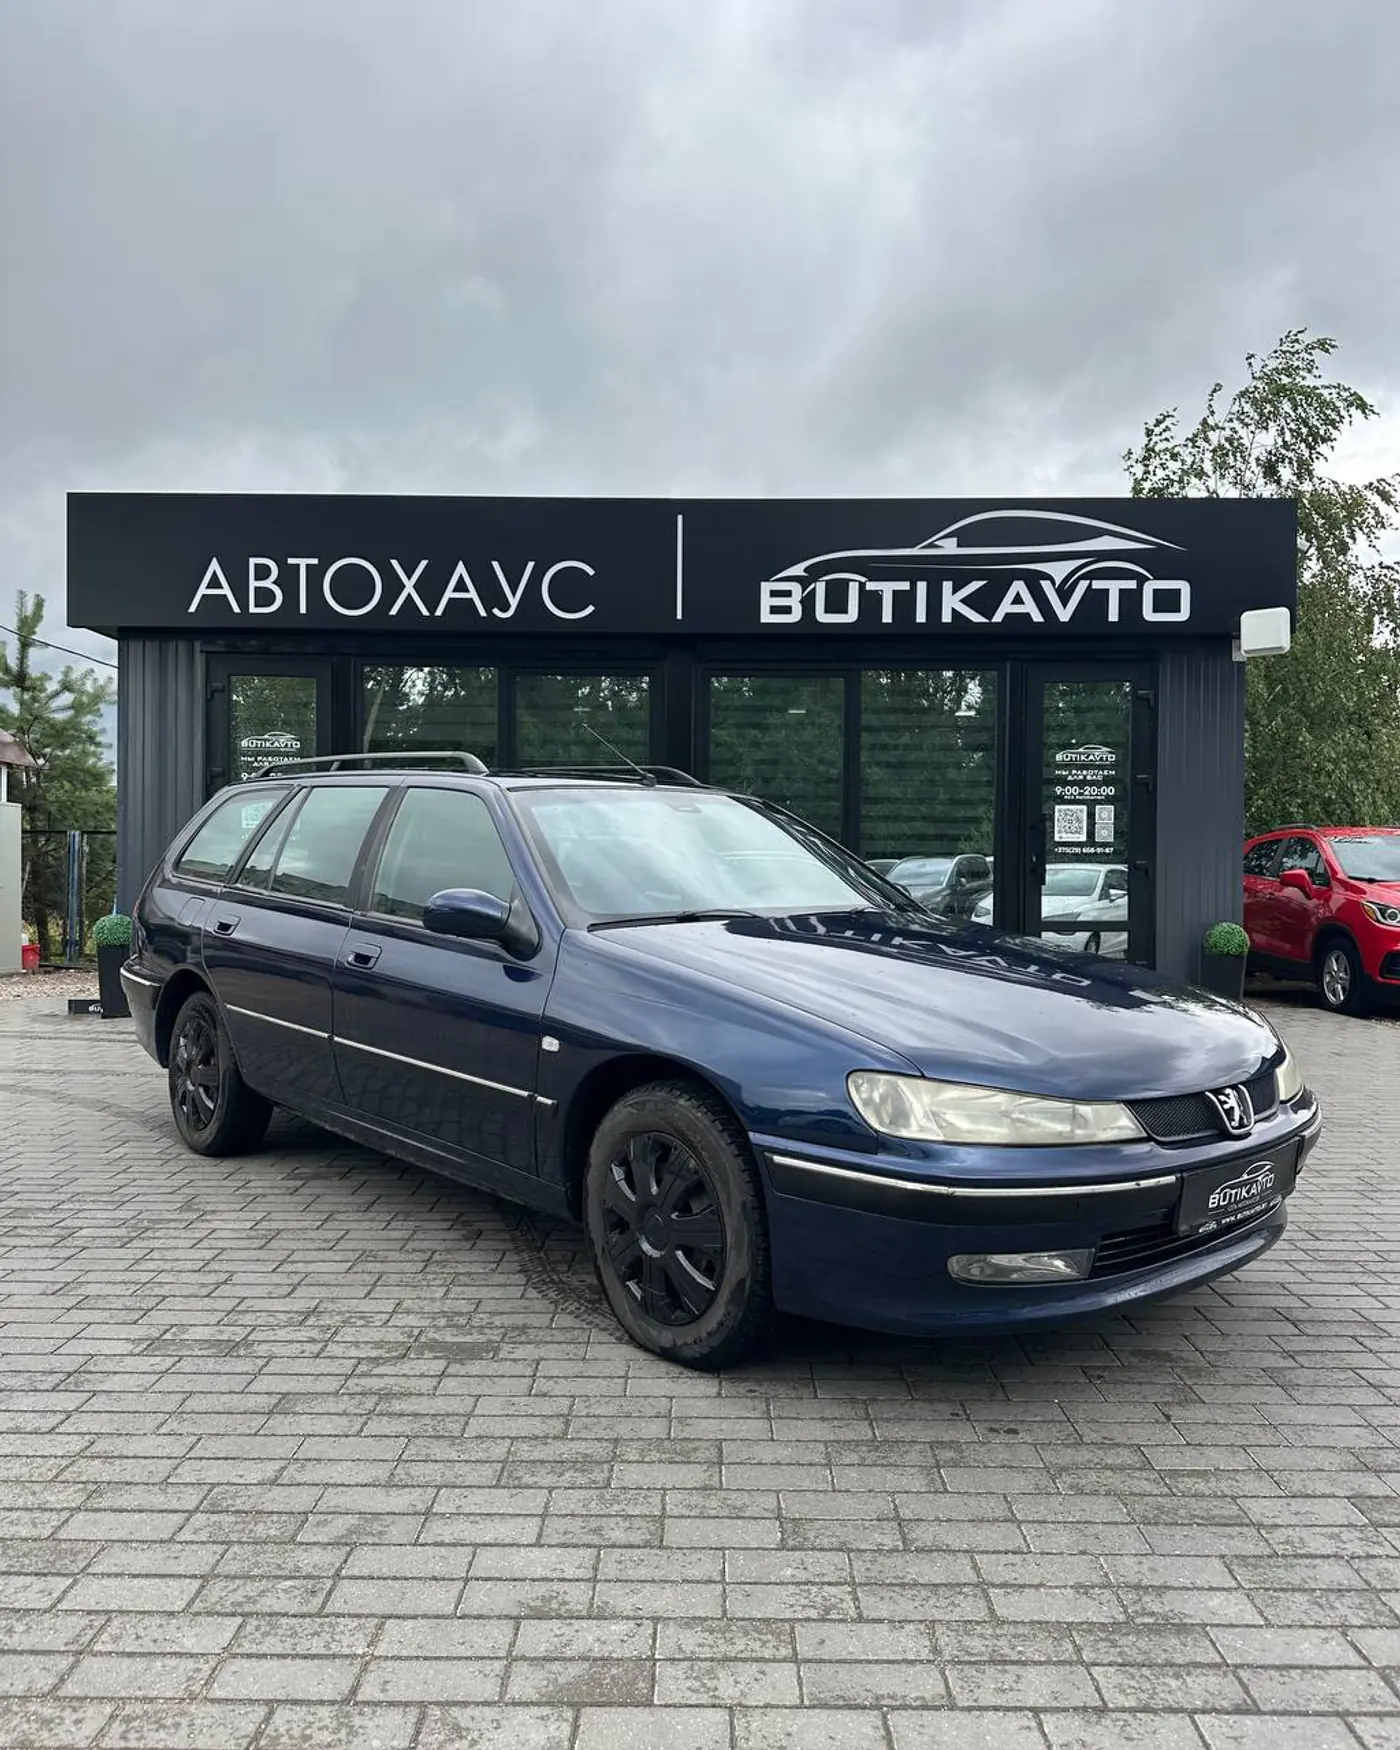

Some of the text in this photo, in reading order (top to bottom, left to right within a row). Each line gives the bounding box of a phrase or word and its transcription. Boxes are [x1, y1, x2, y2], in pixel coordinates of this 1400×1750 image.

[187, 556, 596, 620] АВТОХАУС
[759, 578, 1192, 624] BUTIKAVTO
[241, 740, 301, 748] BUTIKAVTO
[1055, 786, 1115, 795] 9:00-20:00
[1208, 1173, 1275, 1209] BUTIKAVTO
